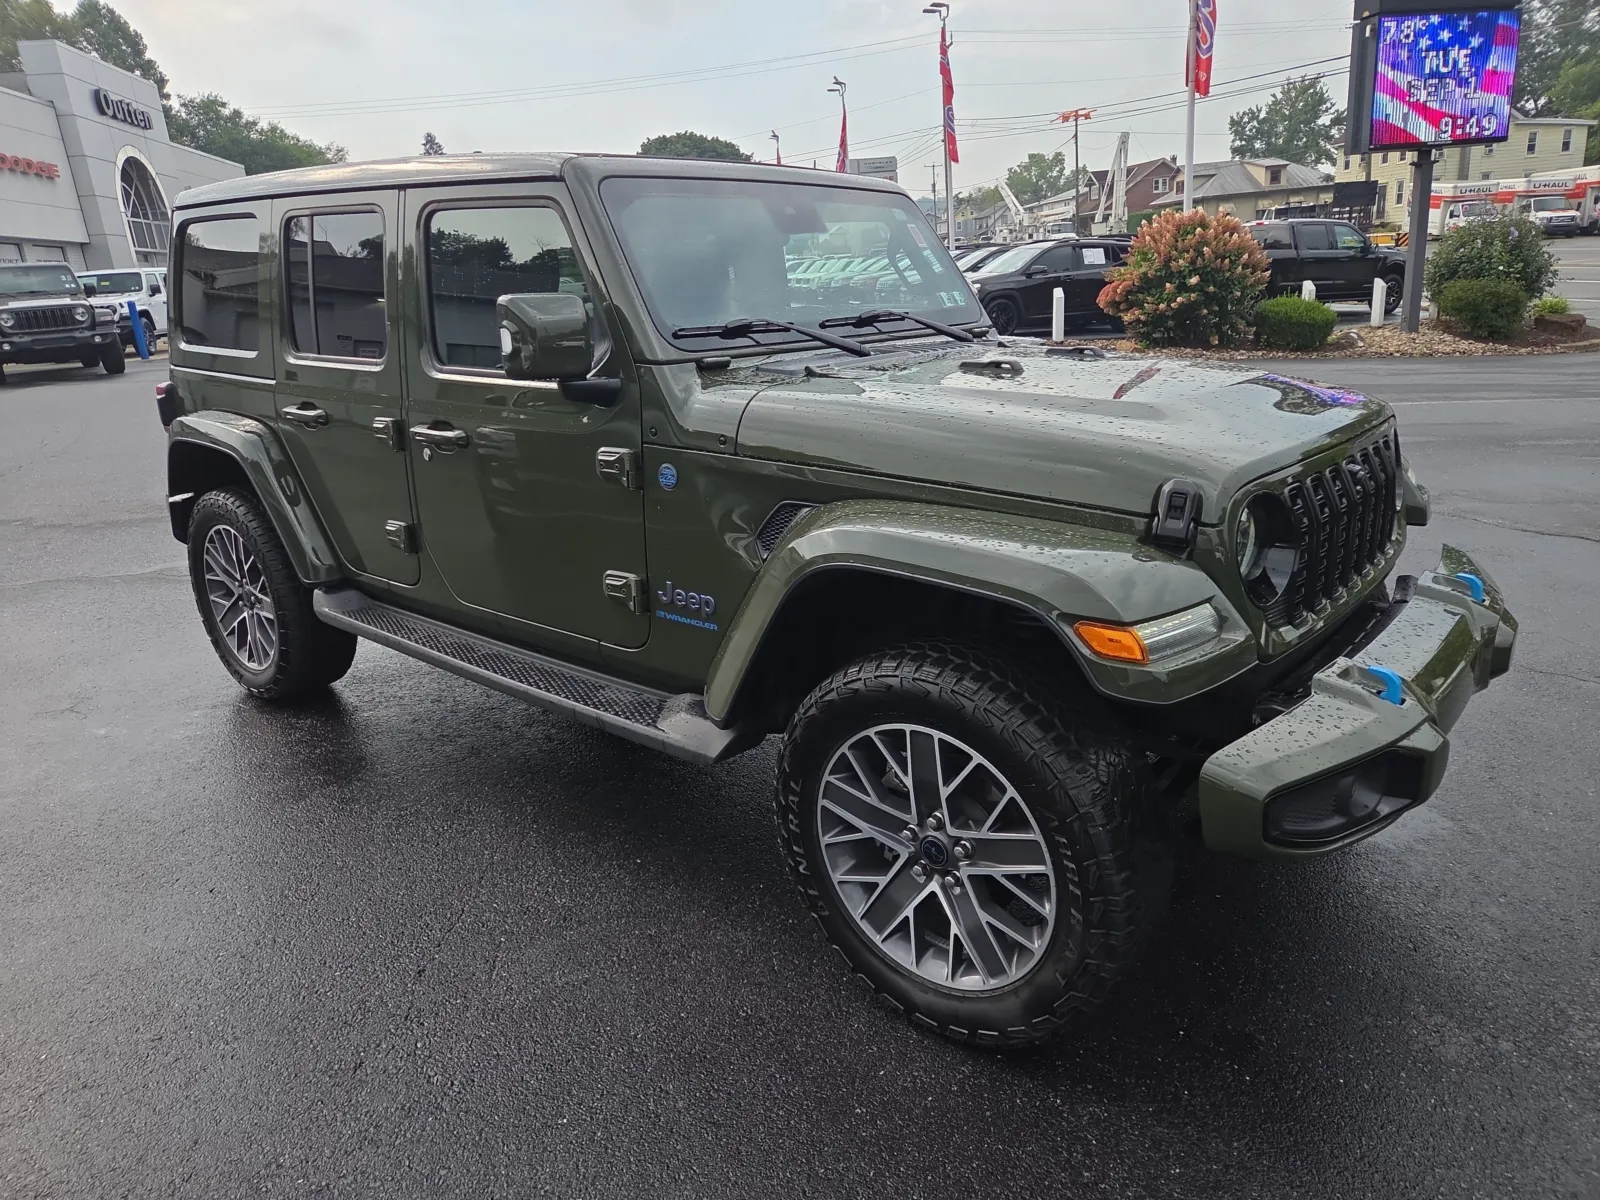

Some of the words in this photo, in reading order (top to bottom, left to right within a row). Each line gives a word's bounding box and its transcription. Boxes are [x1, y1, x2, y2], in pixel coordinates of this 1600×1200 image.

[1421, 48, 1472, 75] TUE
[1406, 78, 1456, 103] SEP
[97, 87, 154, 130] Outten
[1439, 113, 1498, 141] 9:49
[0, 152, 60, 179] DODGE
[1460, 186, 1494, 195] U-HAUL
[1533, 181, 1570, 189] U-HAUL
[657, 580, 716, 619] Jeep
[664, 611, 719, 631] WRANGLER
